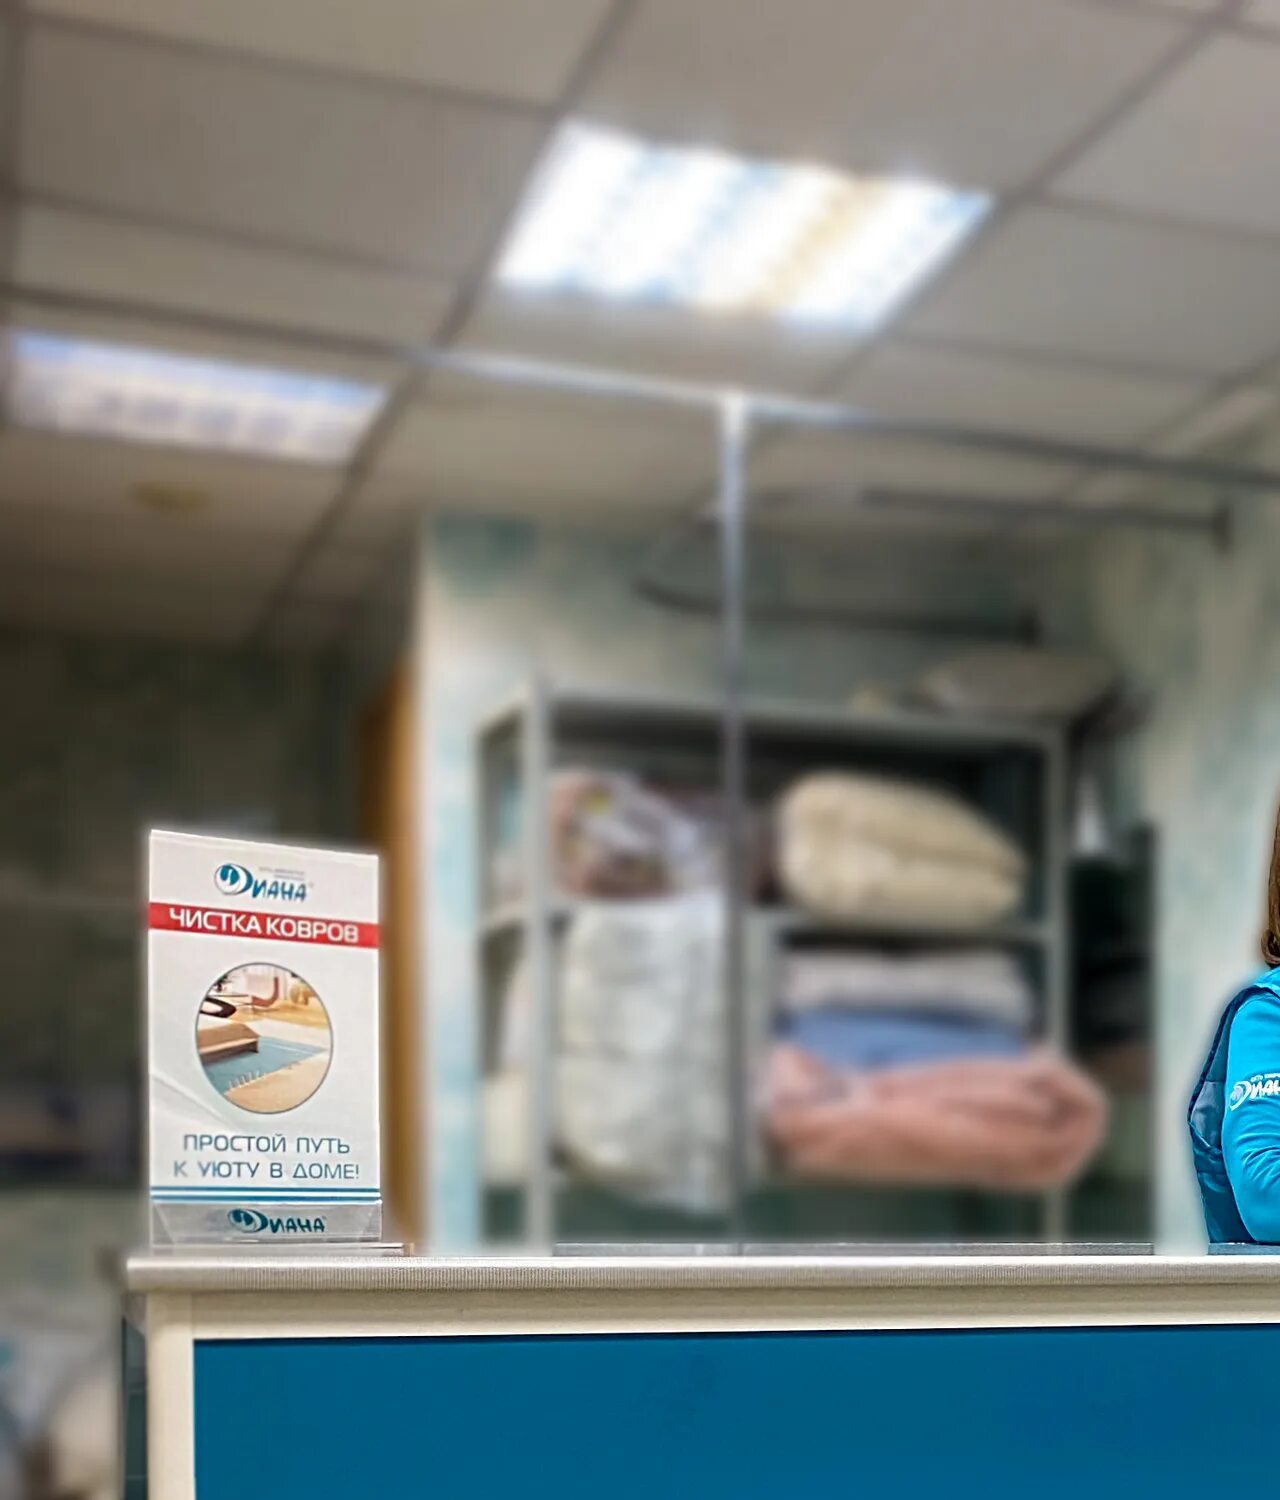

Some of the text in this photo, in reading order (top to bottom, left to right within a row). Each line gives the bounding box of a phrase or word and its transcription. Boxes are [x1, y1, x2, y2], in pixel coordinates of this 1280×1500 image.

[169, 906, 360, 943] ЧИСТКА КОВРОВ
[183, 1133, 351, 1154] ПРОСТОЙ ПУТЬ
[173, 1161, 360, 1180] К УЮТУ В ДОМЕ!
